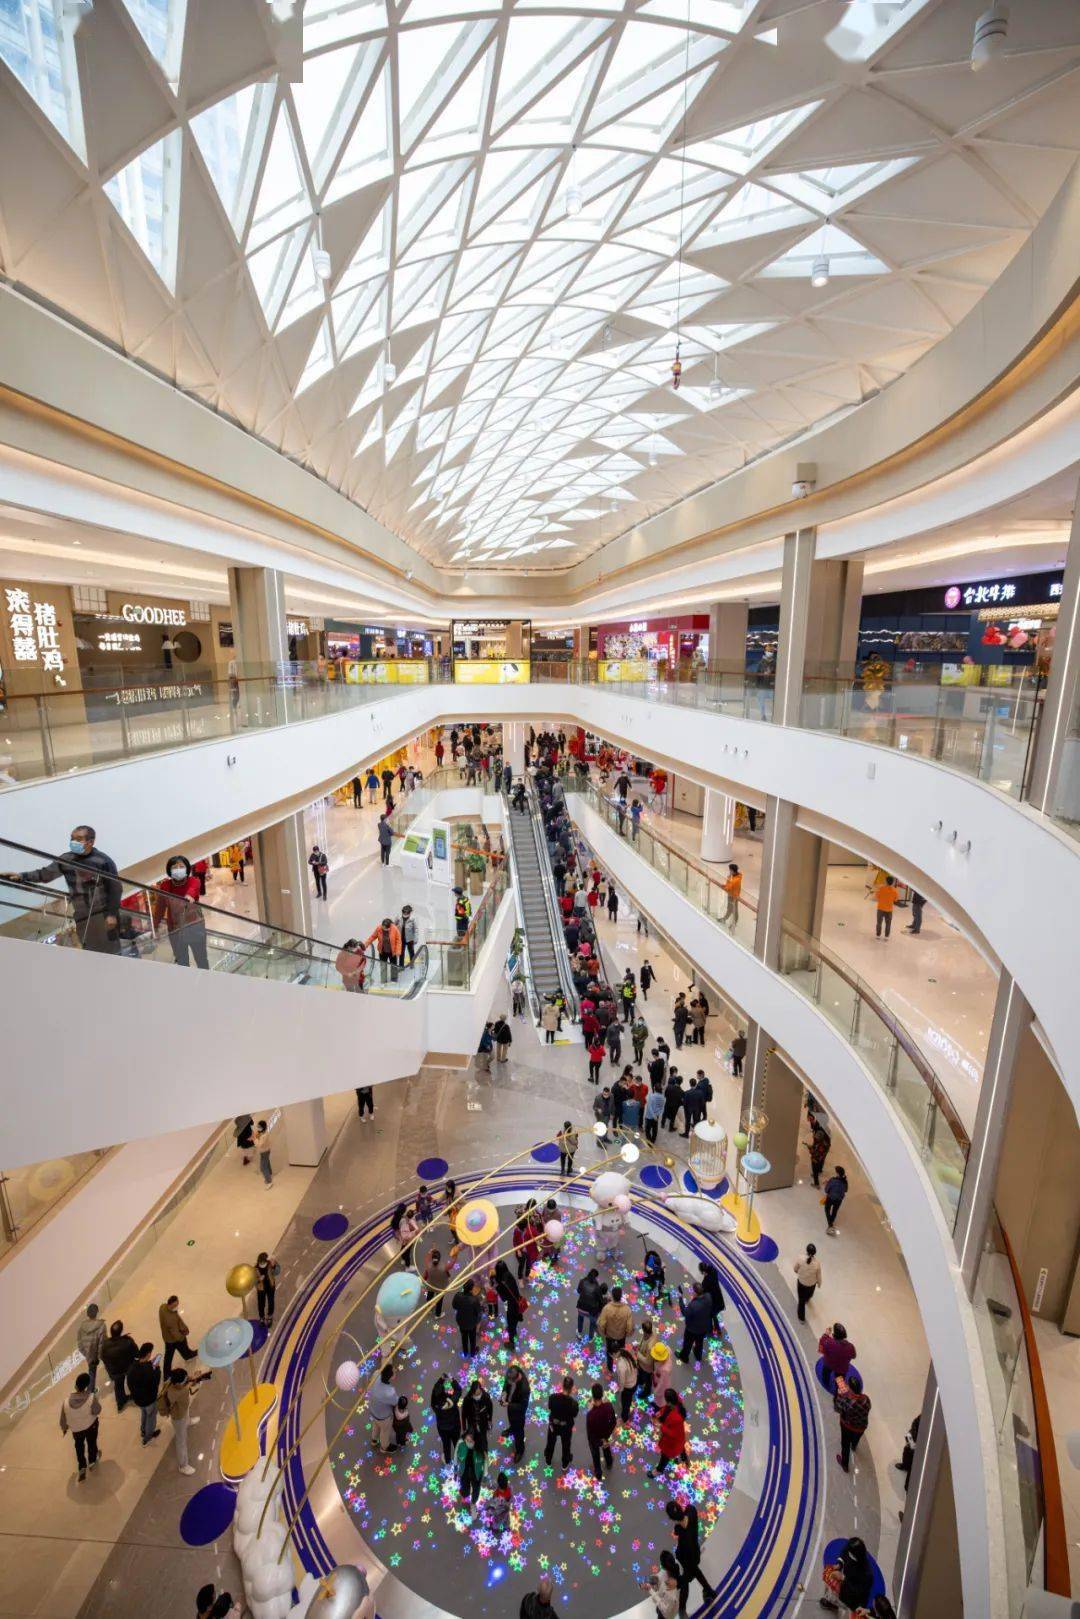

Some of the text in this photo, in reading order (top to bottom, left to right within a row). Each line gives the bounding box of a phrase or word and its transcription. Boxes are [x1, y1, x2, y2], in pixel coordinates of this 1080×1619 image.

[33, 602, 64, 672] 猪肚鸡
[122, 604, 187, 626] GOODHEE
